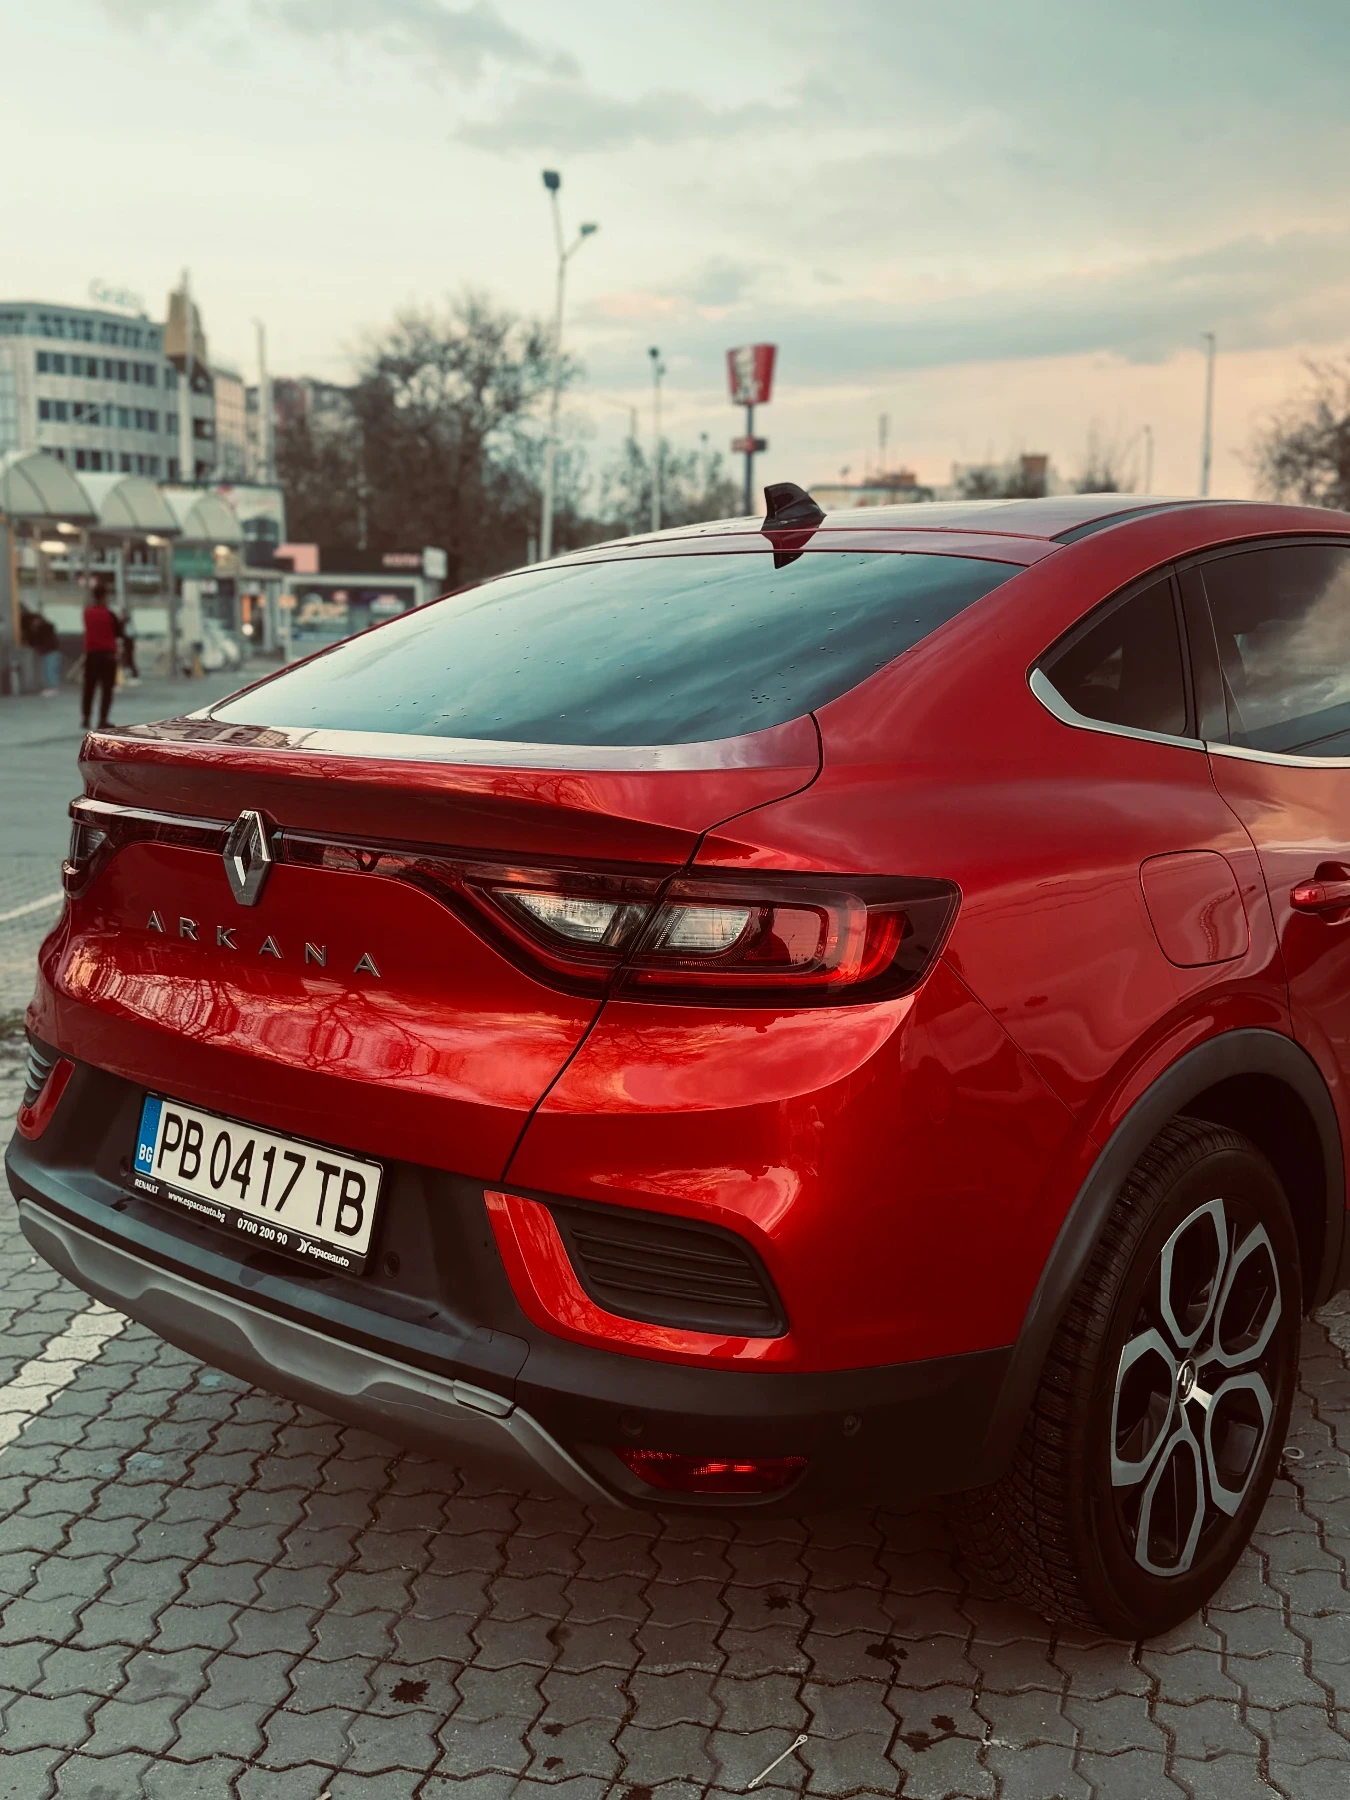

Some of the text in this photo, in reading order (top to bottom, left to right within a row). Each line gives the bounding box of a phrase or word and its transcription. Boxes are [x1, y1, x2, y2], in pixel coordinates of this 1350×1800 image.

[146, 910, 382, 978] ARKANA
[138, 1143, 153, 1163] BG
[134, 1178, 159, 1193] RENAULT
[157, 1111, 367, 1237] PB 0417 TB
[168, 1191, 226, 1223] www.espaceauto.bg
[237, 1217, 288, 1245] 0700 200 90
[308, 1244, 350, 1267] espaceauto
